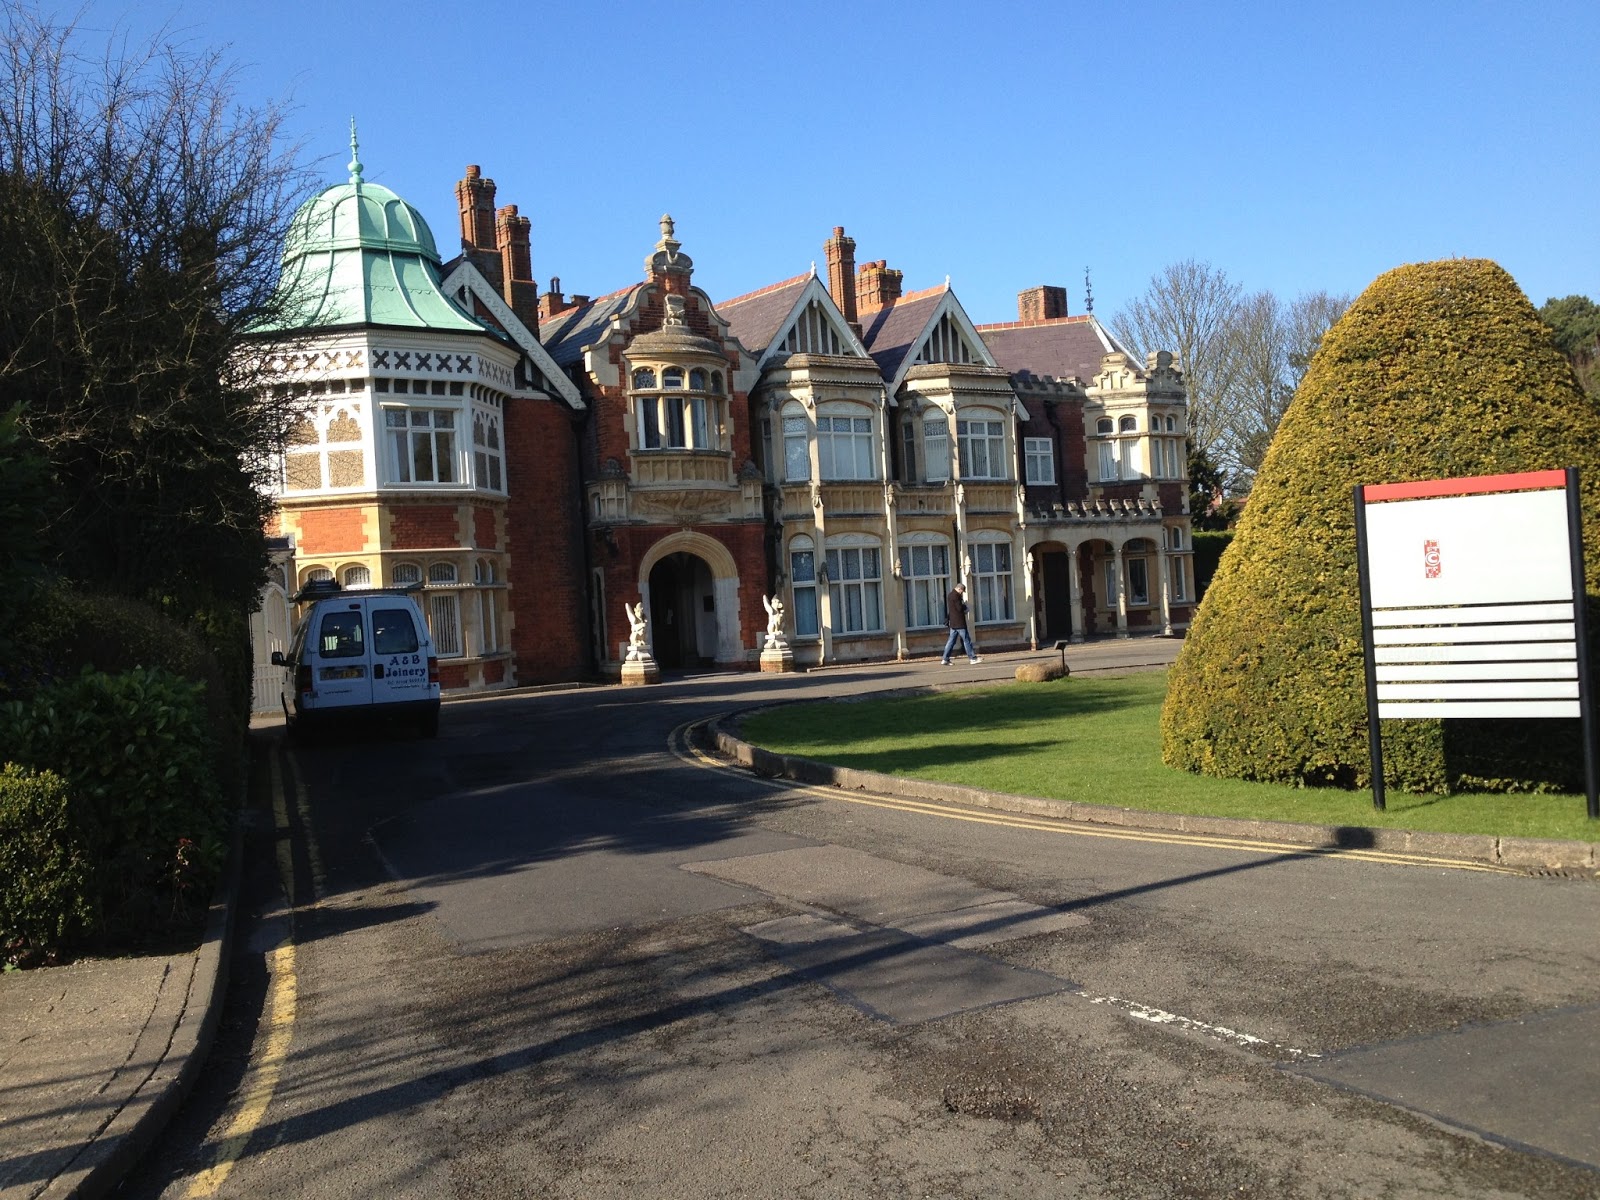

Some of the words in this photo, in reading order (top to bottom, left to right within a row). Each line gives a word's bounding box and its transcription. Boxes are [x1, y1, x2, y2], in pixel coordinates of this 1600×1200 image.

[390, 656, 399, 666] A
[402, 656, 409, 665] &
[412, 654, 420, 664] B
[386, 667, 426, 678] Joinery
